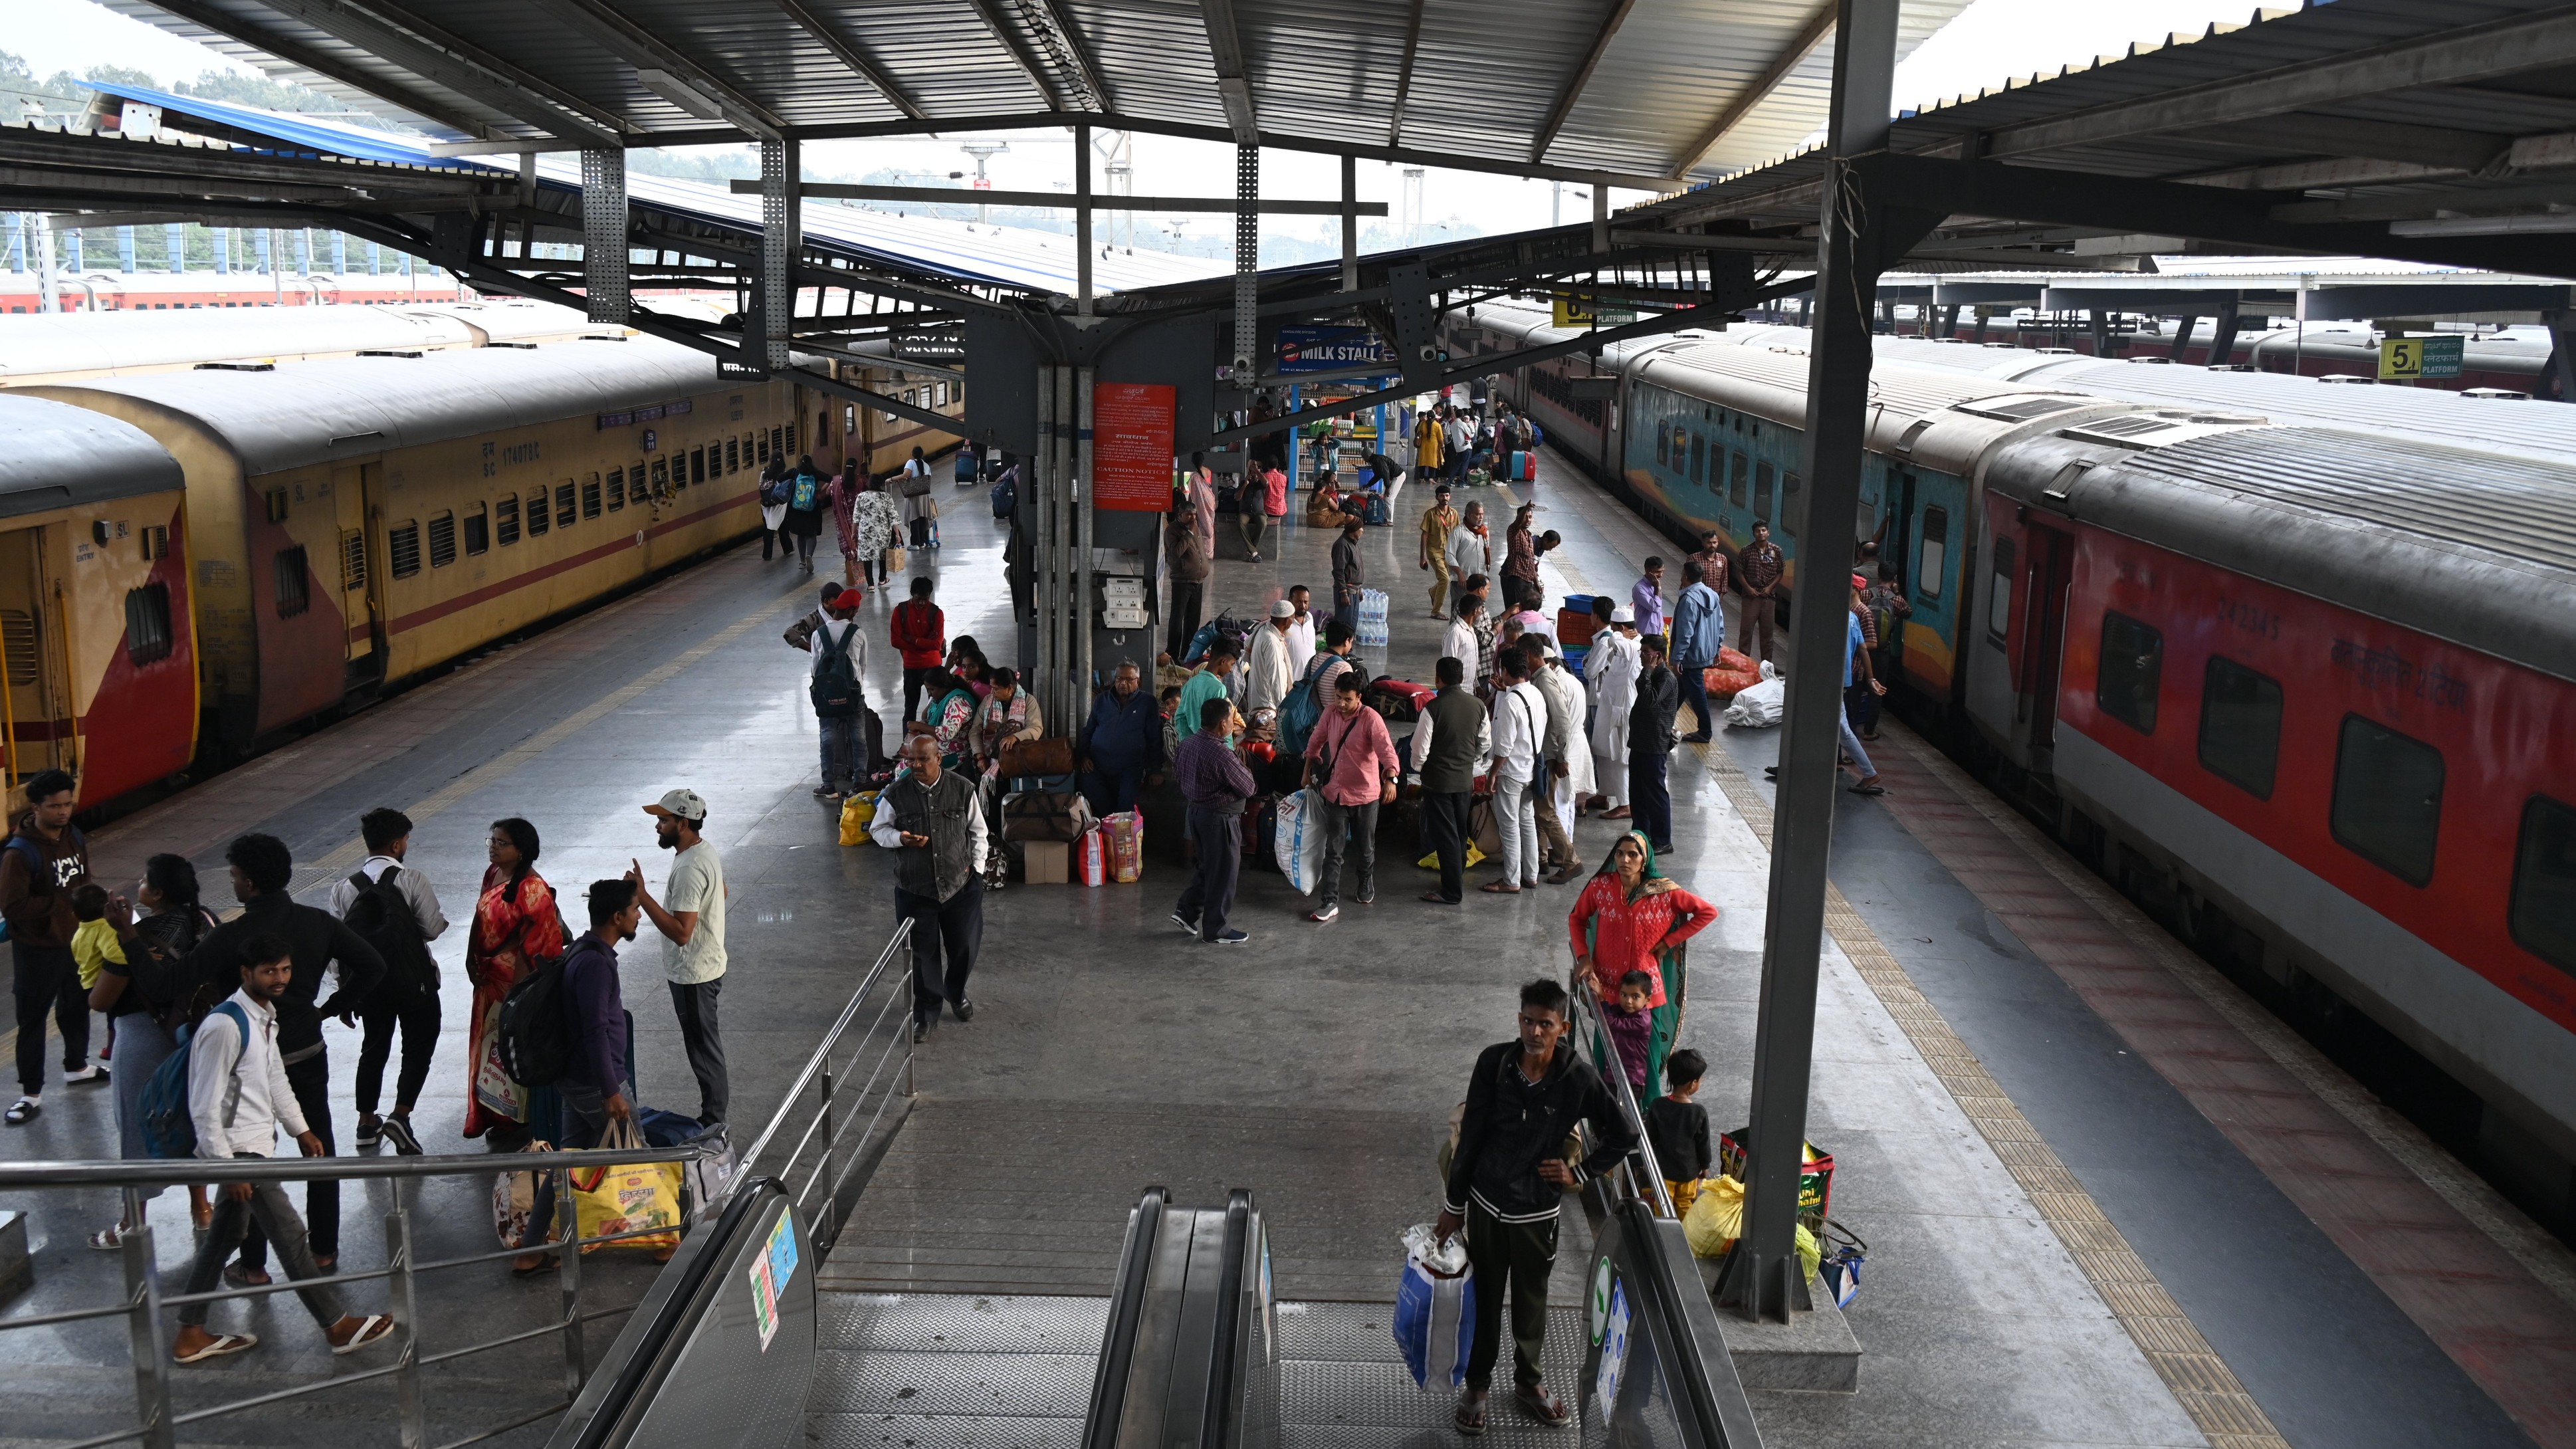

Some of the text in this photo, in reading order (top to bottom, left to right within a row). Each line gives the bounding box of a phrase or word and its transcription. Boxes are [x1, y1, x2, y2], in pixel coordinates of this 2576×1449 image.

[1596, 314, 1633, 323] PLATFORM
[1301, 346, 1335, 360] MILK
[1338, 346, 1378, 362] STALL
[2392, 344, 2409, 368] 5
[2422, 352, 2459, 362] प्लेटफार्म
[484, 461, 495, 478] SC
[296, 484, 304, 502] SL
[118, 522, 128, 537] SL
[76, 552, 95, 562] ENTRY
